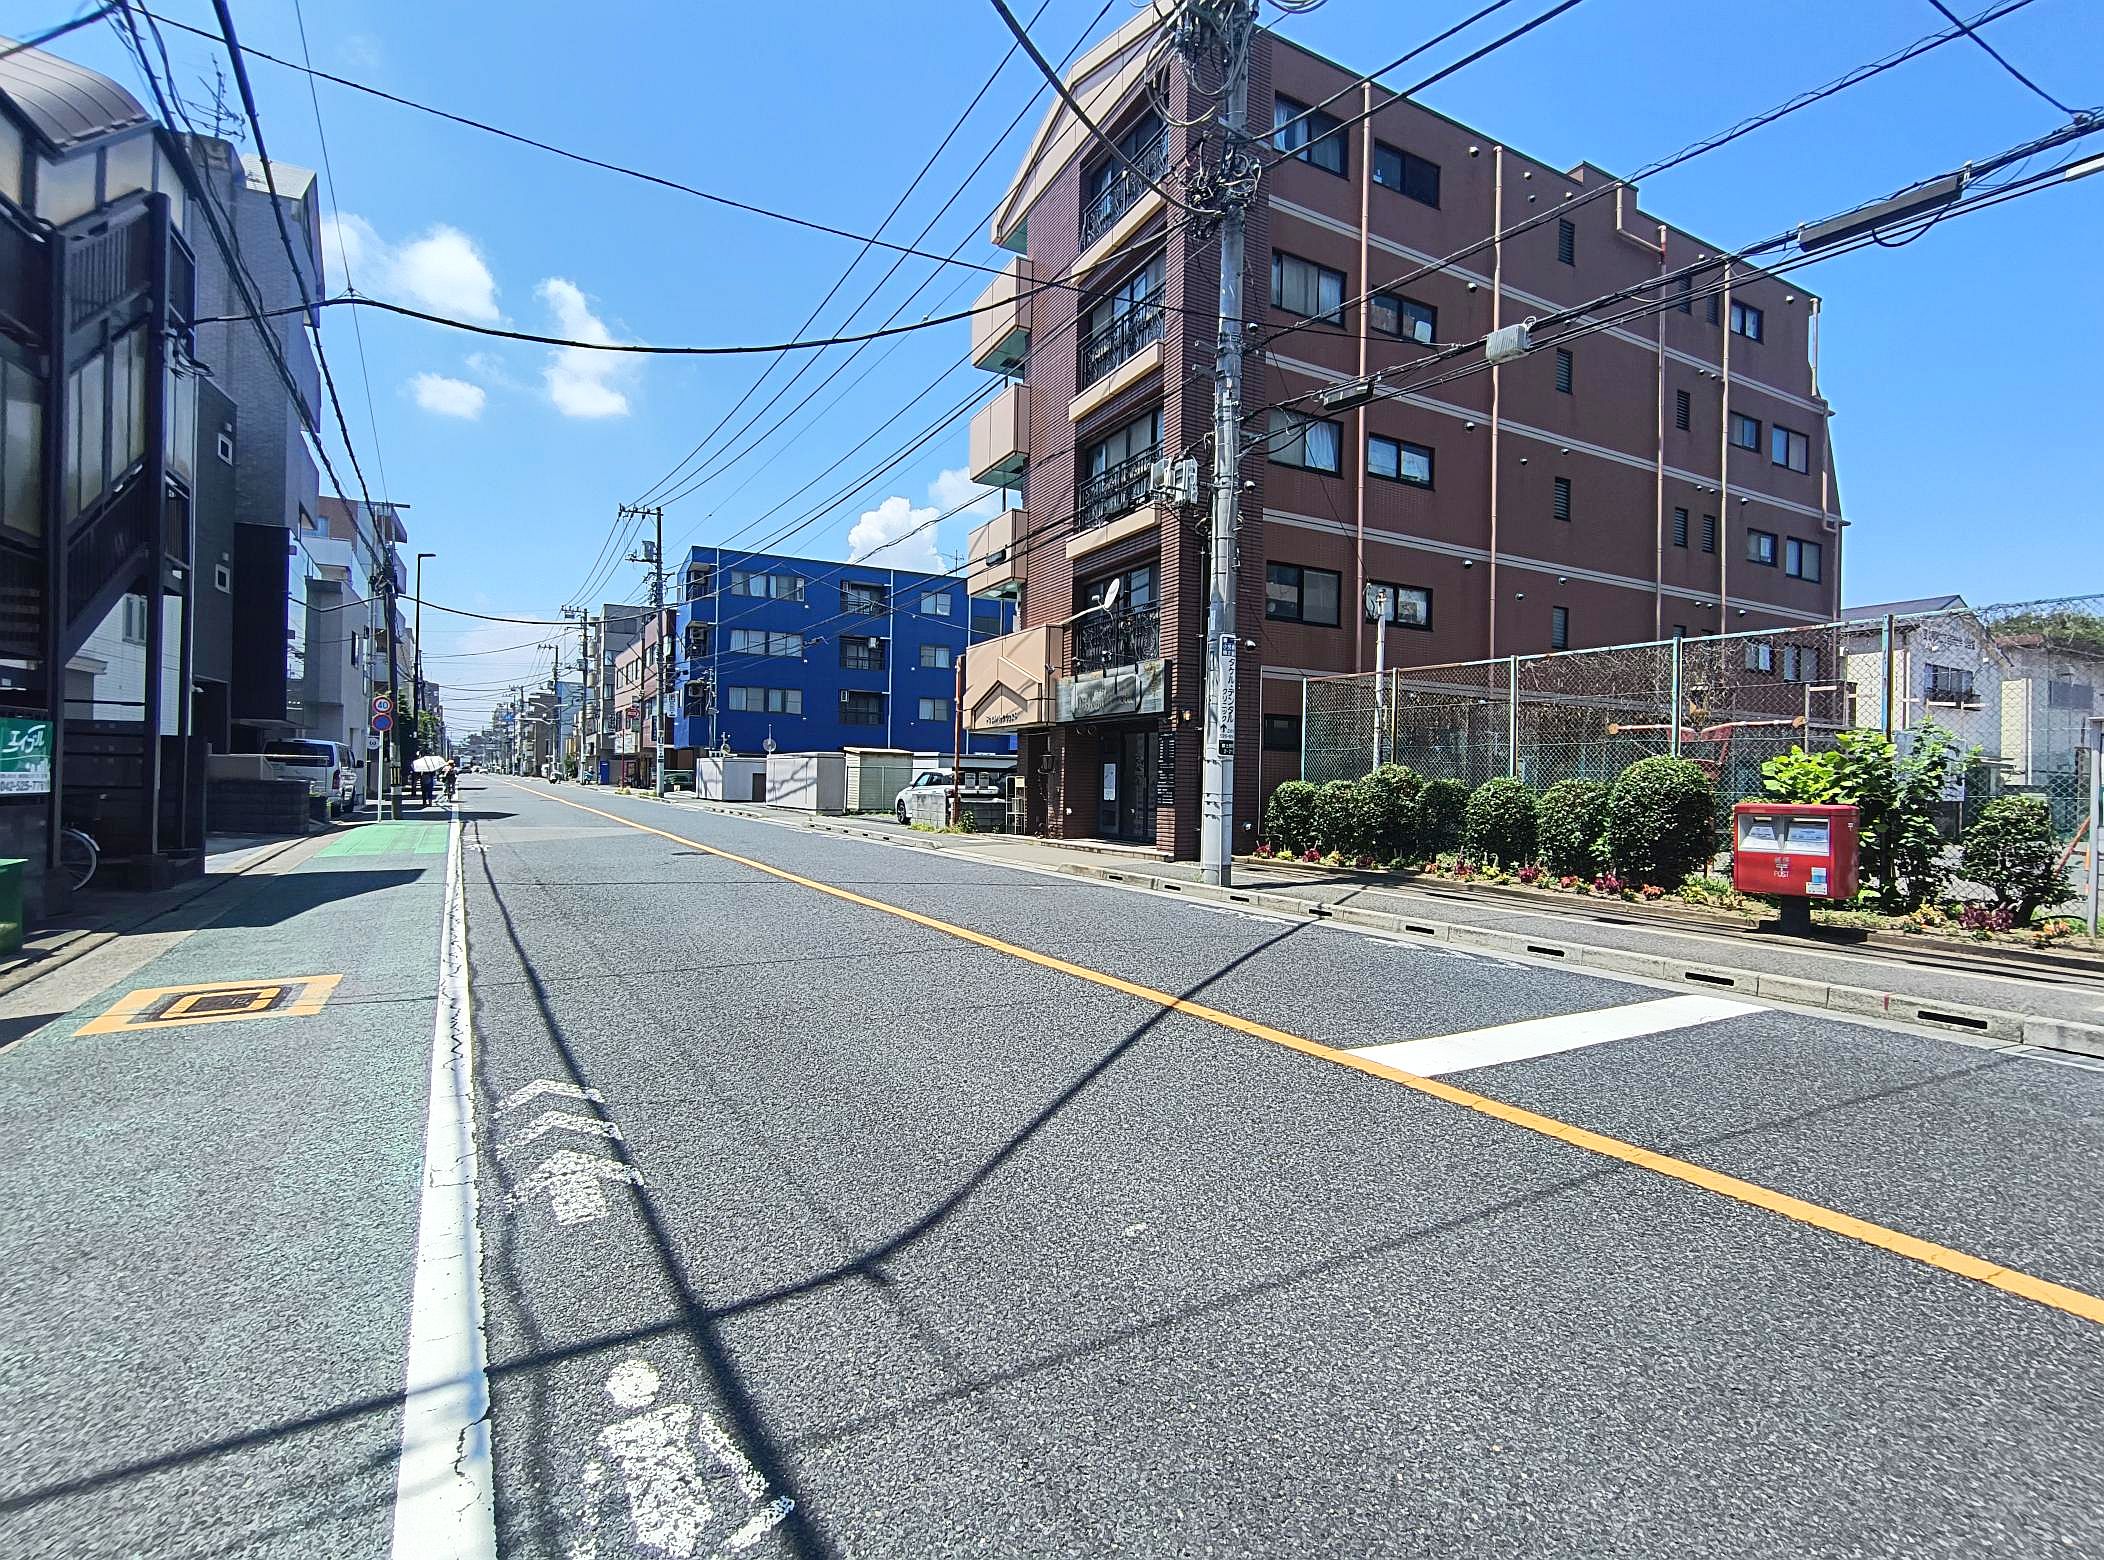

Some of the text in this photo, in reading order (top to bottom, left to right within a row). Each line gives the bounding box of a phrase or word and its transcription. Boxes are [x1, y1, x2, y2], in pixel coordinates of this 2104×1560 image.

[1227, 658, 1235, 723] タケル・デンタル
[377, 702, 389, 710] 40
[8, 725, 46, 753] エイブル
[1773, 870, 1789, 878] POST
